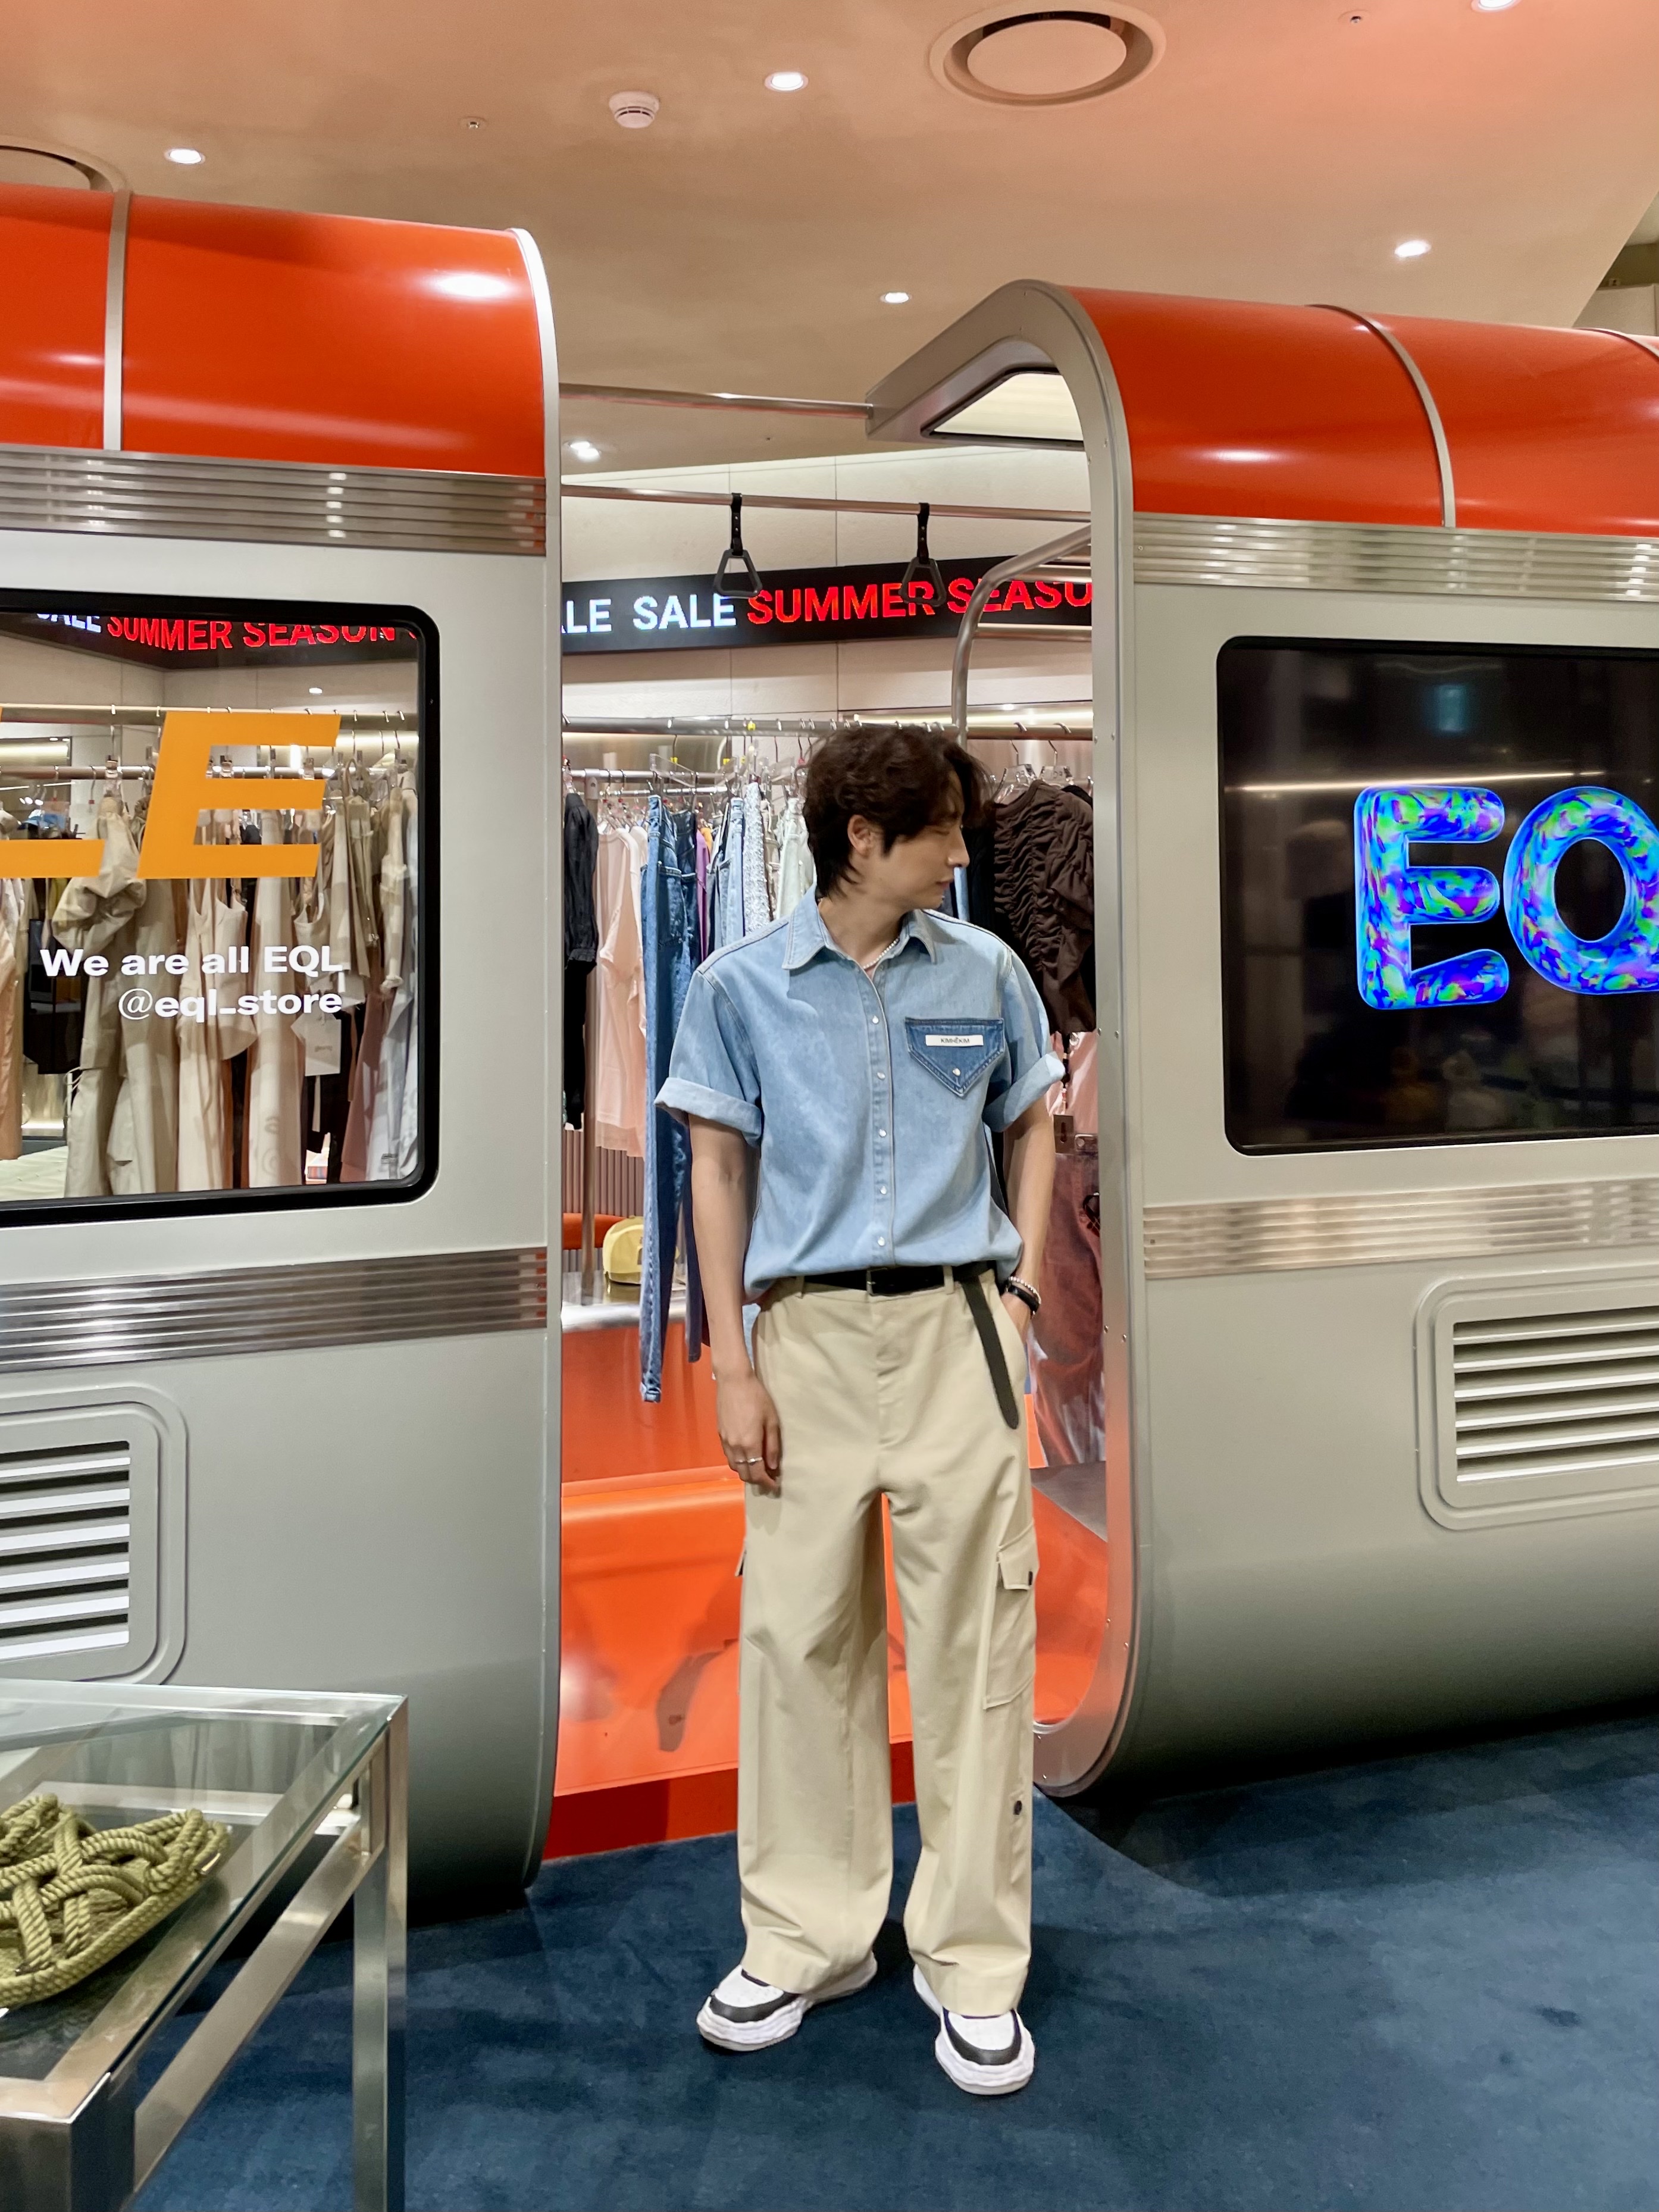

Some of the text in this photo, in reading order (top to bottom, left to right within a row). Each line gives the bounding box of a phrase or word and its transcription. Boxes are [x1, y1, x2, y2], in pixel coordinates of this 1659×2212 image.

[561, 598, 612, 633] LE
[633, 593, 737, 630] SALE
[747, 581, 936, 625] SUMMER
[36, 614, 395, 650] LE SUMMER SEASON
[40, 945, 343, 978] We are all EQL
[118, 988, 343, 1024] @eql_store
